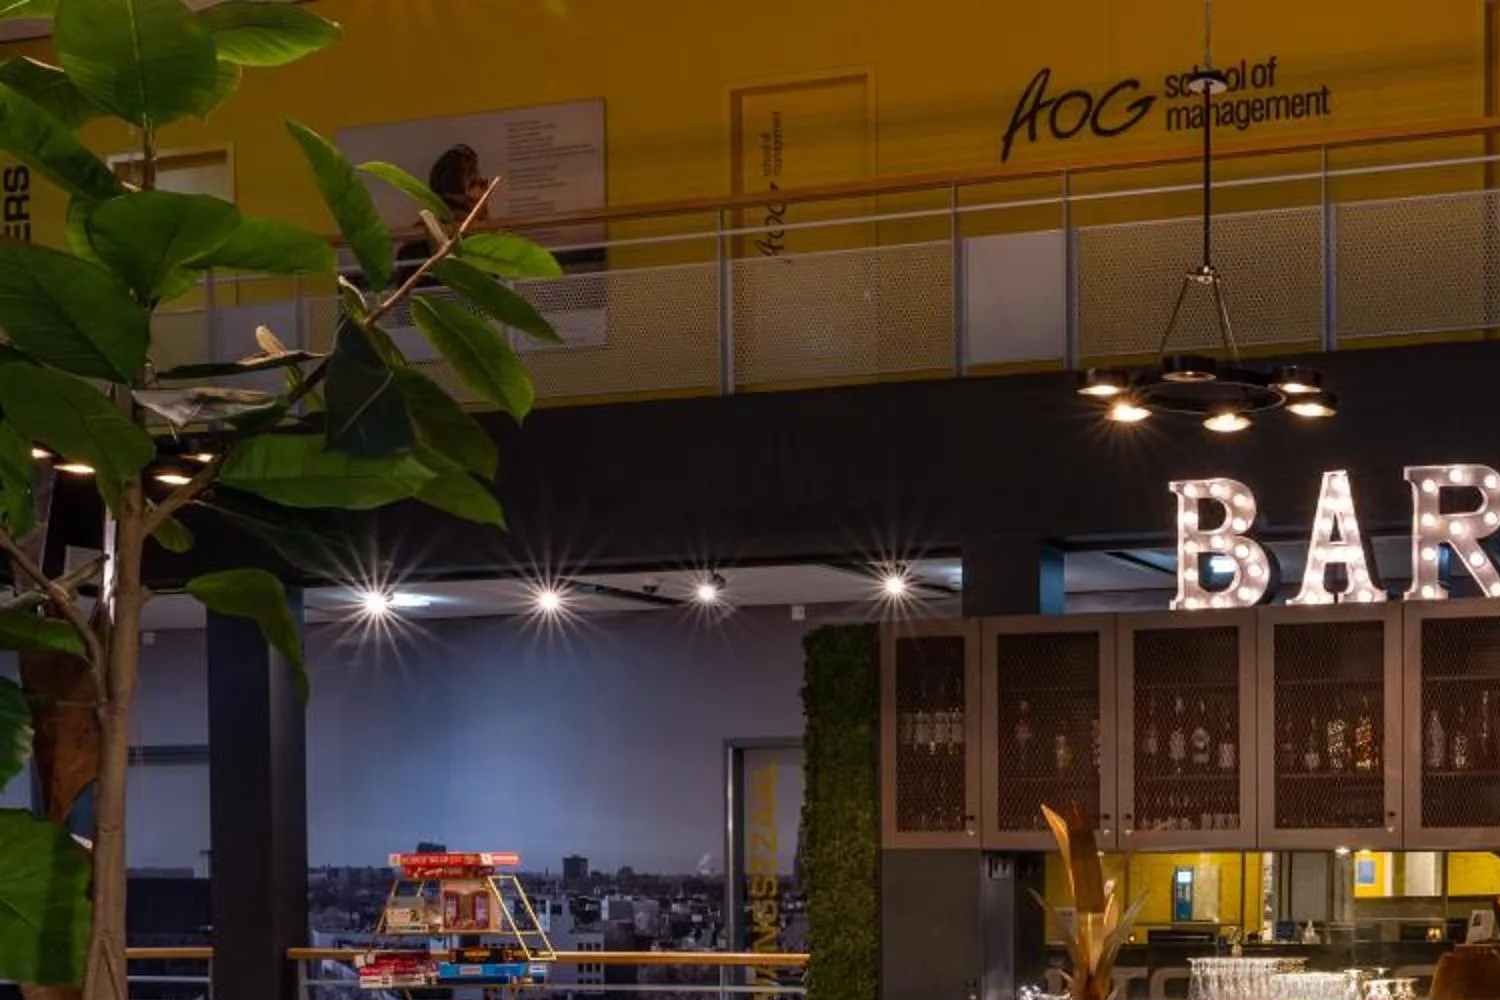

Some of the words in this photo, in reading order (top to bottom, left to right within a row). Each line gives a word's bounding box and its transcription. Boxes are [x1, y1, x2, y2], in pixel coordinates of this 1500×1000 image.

[1164, 59, 1247, 99] scol
[1251, 56, 1278, 88] of
[1002, 68, 1157, 162] AOG
[1166, 86, 1331, 131] management
